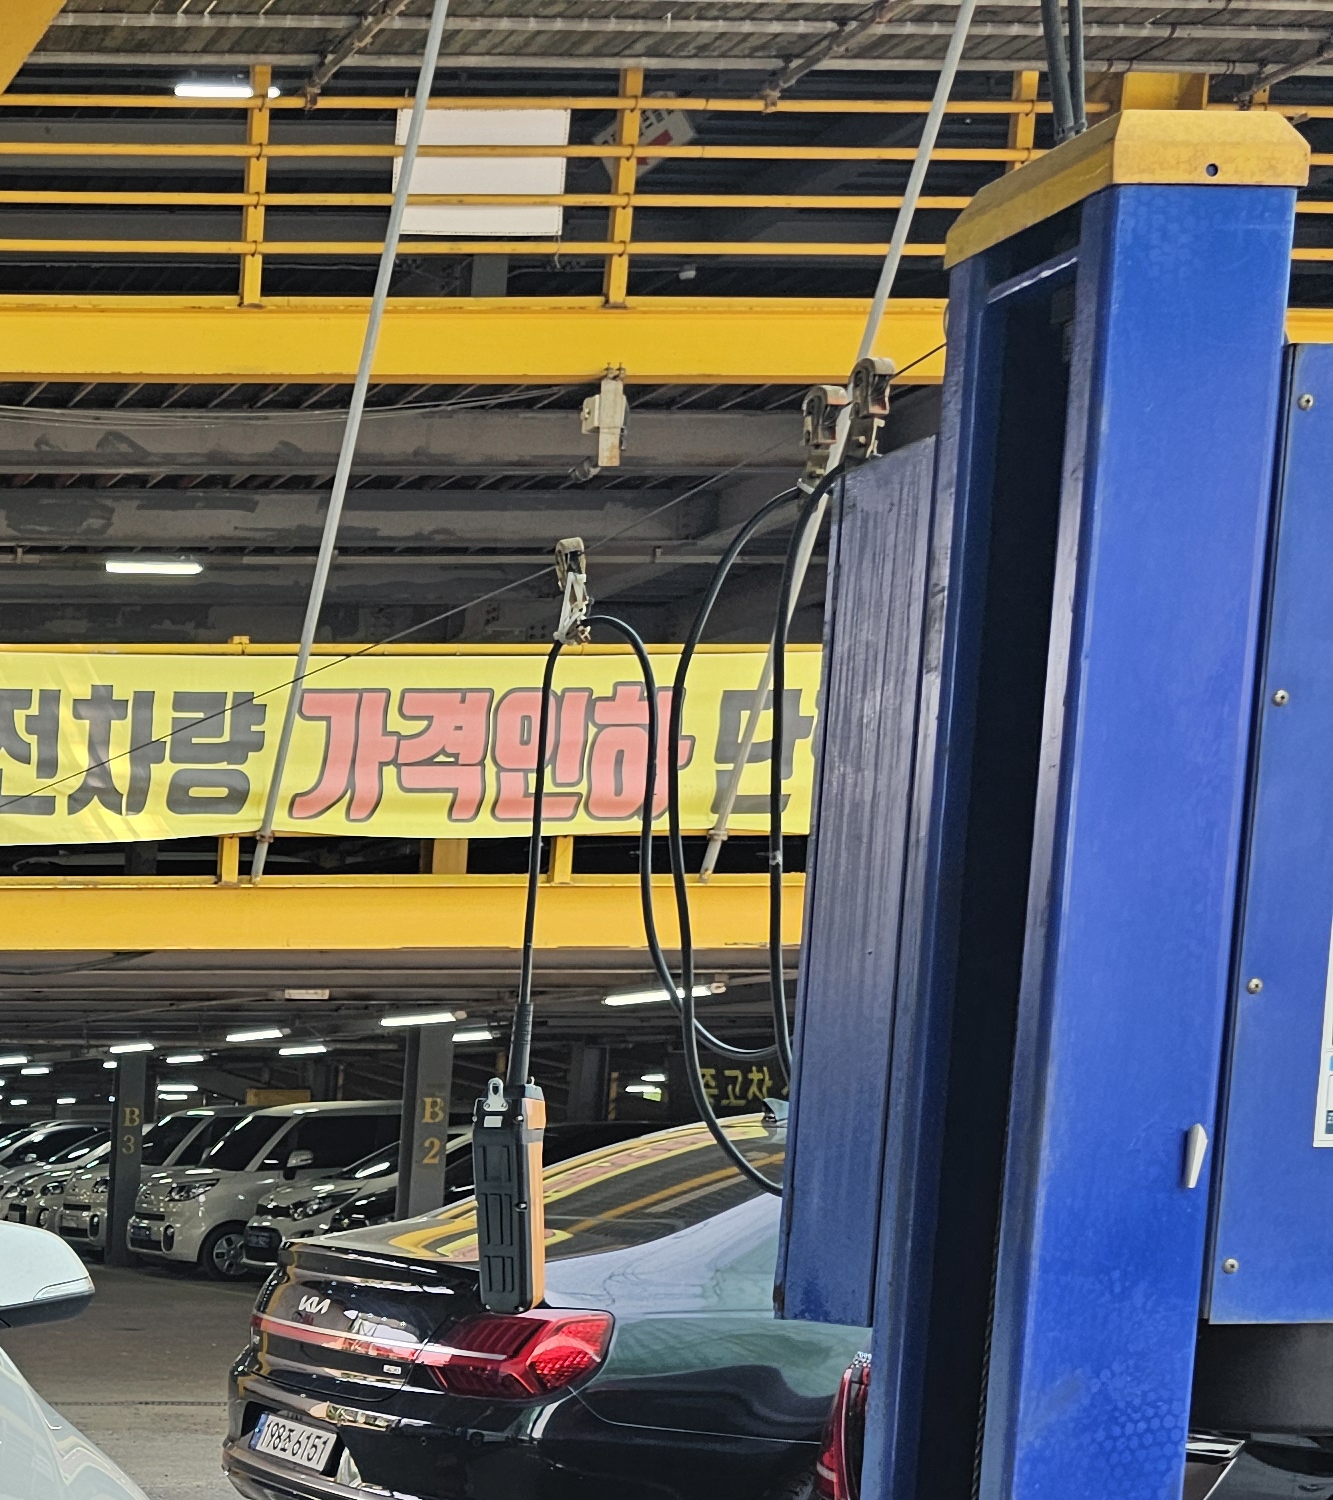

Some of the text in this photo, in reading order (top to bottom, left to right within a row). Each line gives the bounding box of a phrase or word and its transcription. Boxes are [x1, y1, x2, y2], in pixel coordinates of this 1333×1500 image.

[287, 681, 696, 823] 가격인하
[710, 687, 818, 815] 단
[122, 1134, 136, 1155] 3
[422, 1137, 441, 1165] 2
